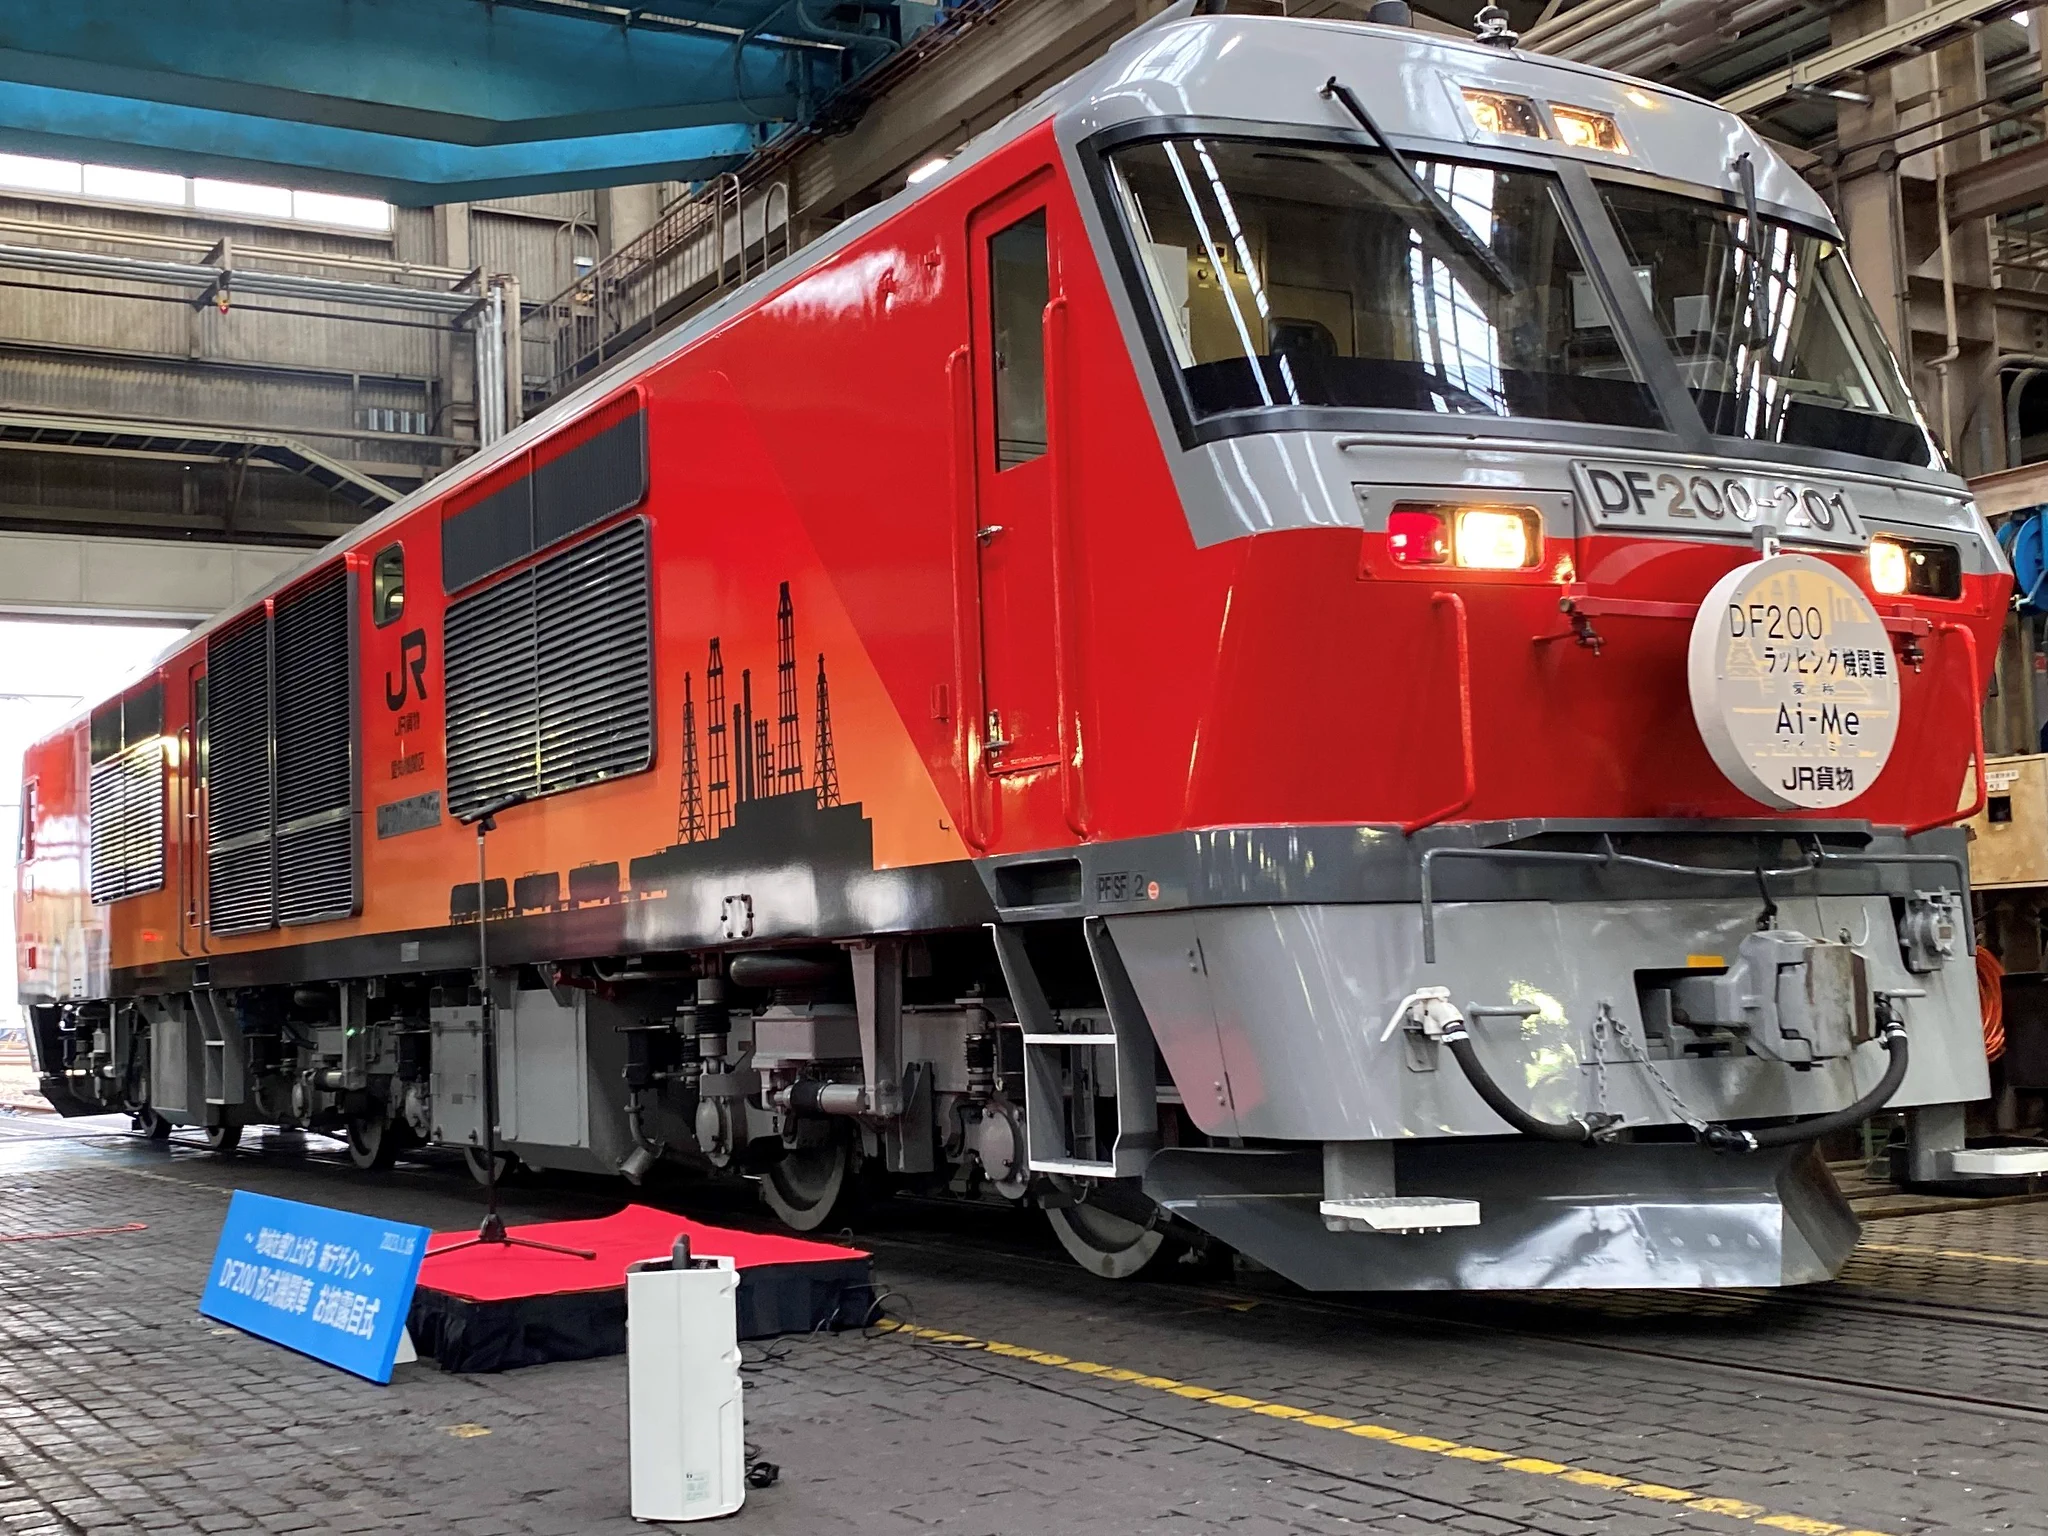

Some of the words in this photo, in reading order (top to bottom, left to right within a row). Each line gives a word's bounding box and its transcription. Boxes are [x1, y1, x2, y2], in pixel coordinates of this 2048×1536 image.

[1588, 469, 1857, 535] DF200-201
[1728, 604, 1823, 640] DF200
[386, 628, 427, 711] JR
[1764, 646, 1888, 678] ラッピング機関車
[1776, 702, 1859, 736] Ai-Me
[1782, 766, 1854, 791] JR貨物
